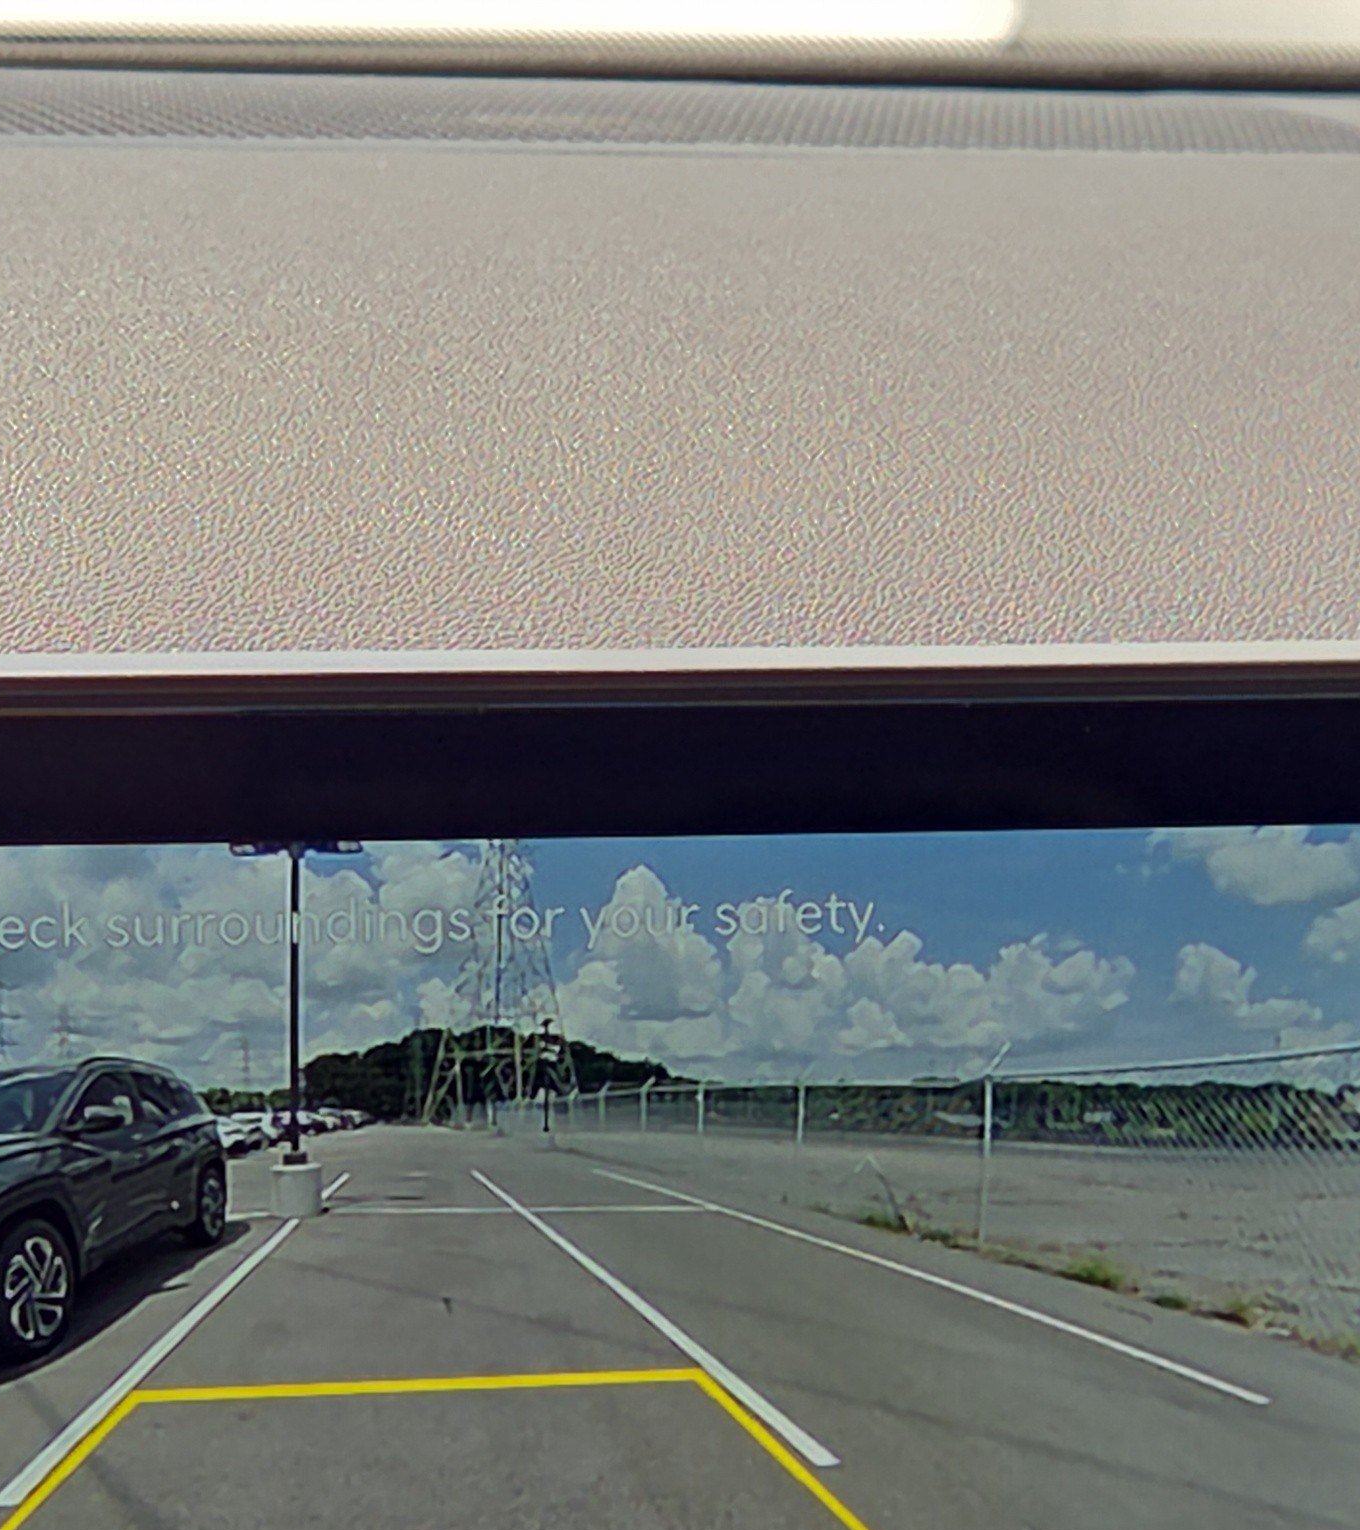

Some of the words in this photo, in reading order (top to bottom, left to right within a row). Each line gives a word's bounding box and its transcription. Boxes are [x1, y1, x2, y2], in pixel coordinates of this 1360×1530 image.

[106, 899, 473, 954] surroundings
[490, 895, 564, 940] for
[580, 899, 699, 952] your
[713, 889, 887, 946] safety.
